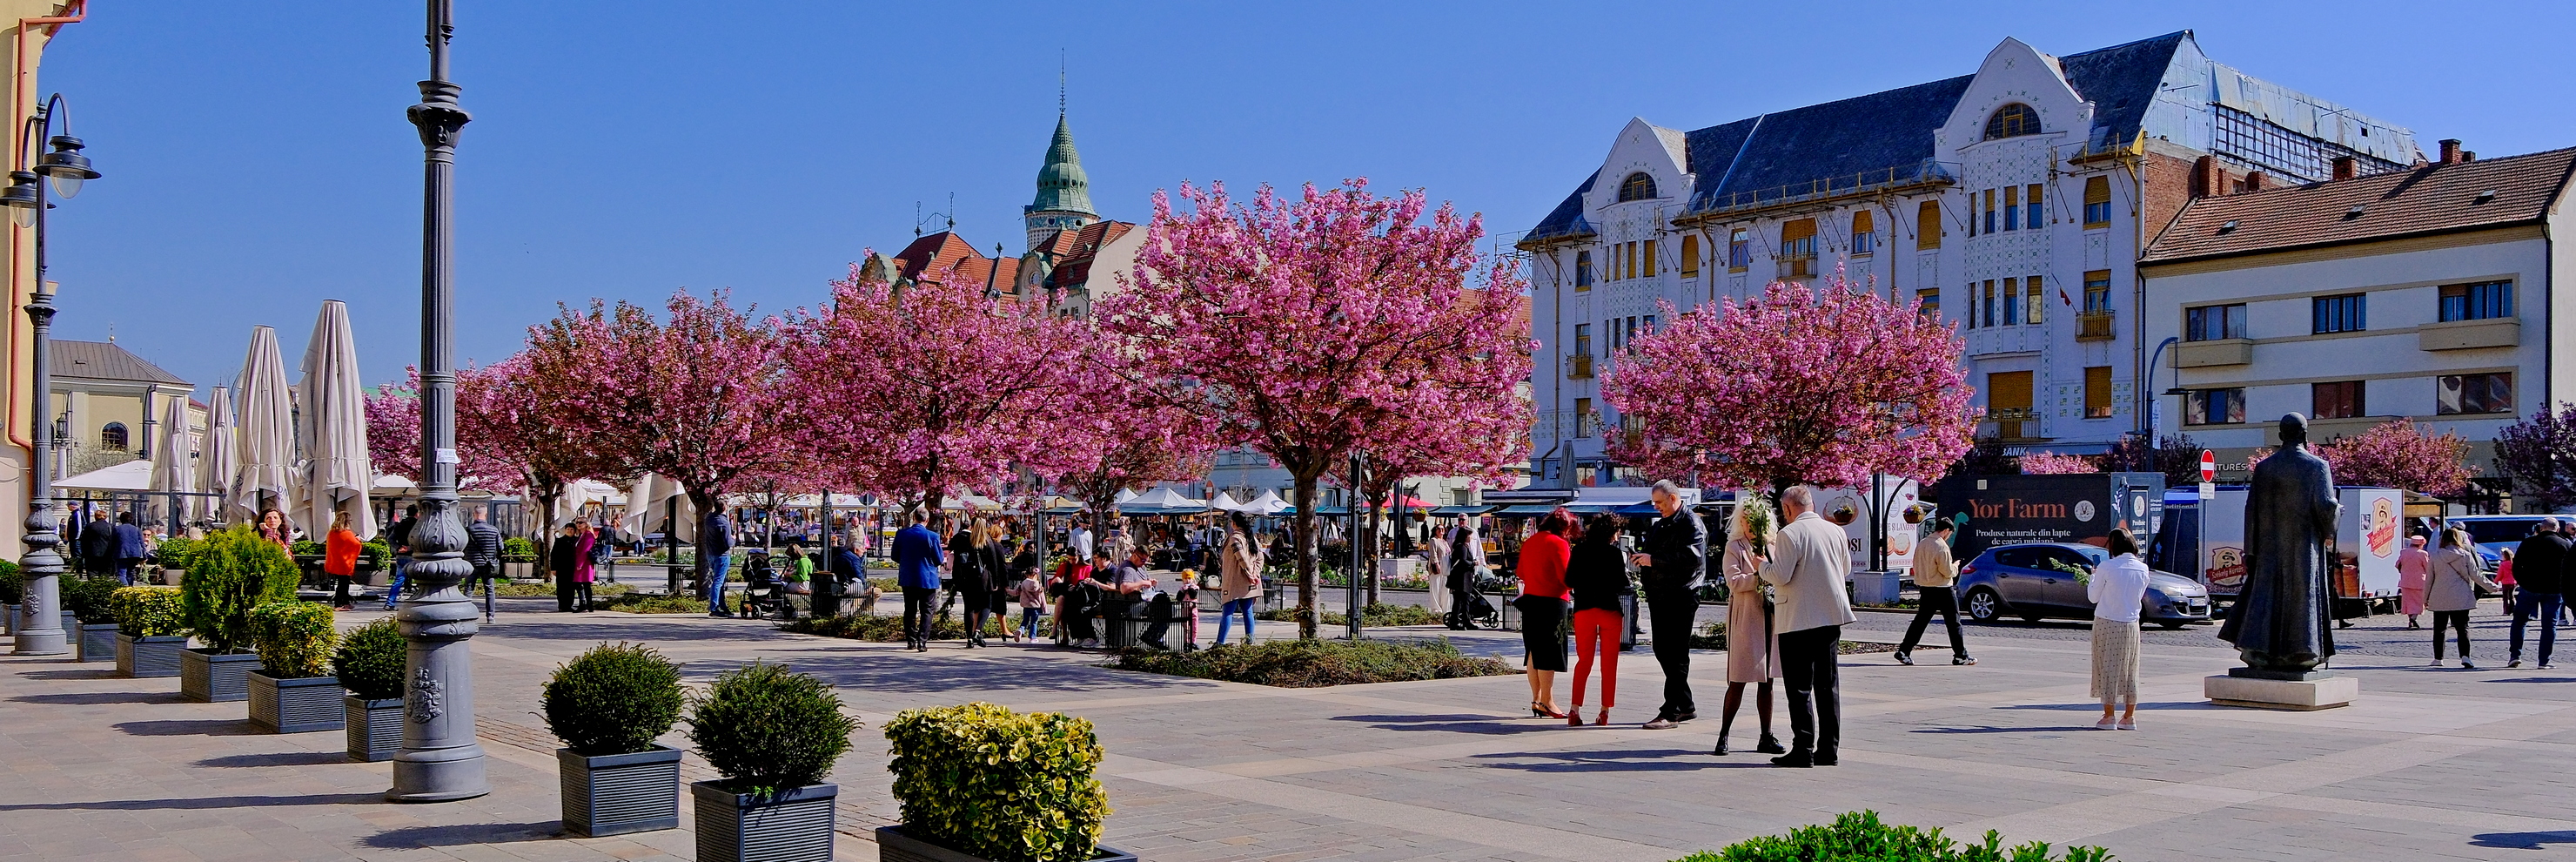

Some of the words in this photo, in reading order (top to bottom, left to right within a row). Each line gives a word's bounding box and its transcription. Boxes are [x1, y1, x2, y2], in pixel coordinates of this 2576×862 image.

[1969, 499, 2002, 519] Yor
[2009, 498, 2066, 519] Farm
[2052, 529, 2071, 538] lapte
